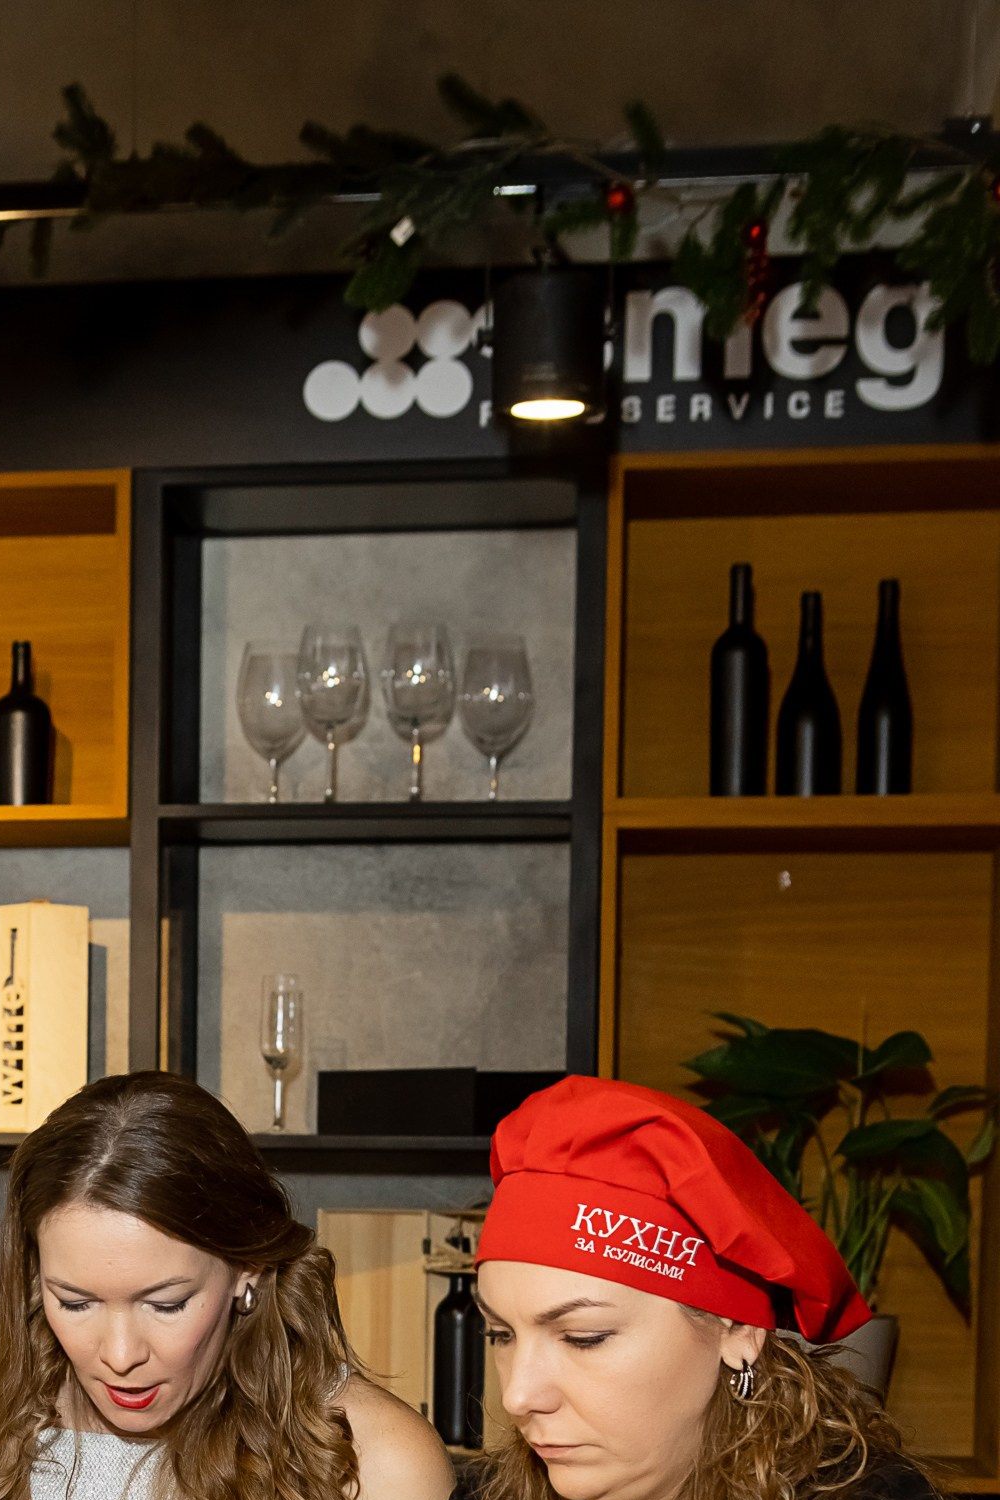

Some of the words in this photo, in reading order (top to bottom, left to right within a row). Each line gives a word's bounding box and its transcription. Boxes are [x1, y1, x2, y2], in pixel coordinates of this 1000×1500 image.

[471, 282, 945, 411] meg
[622, 390, 846, 424] SERVICE
[570, 1203, 705, 1267] КУХНЯ
[574, 1237, 596, 1254] ЗА
[602, 1244, 686, 1281] КУЛИСАМИ
